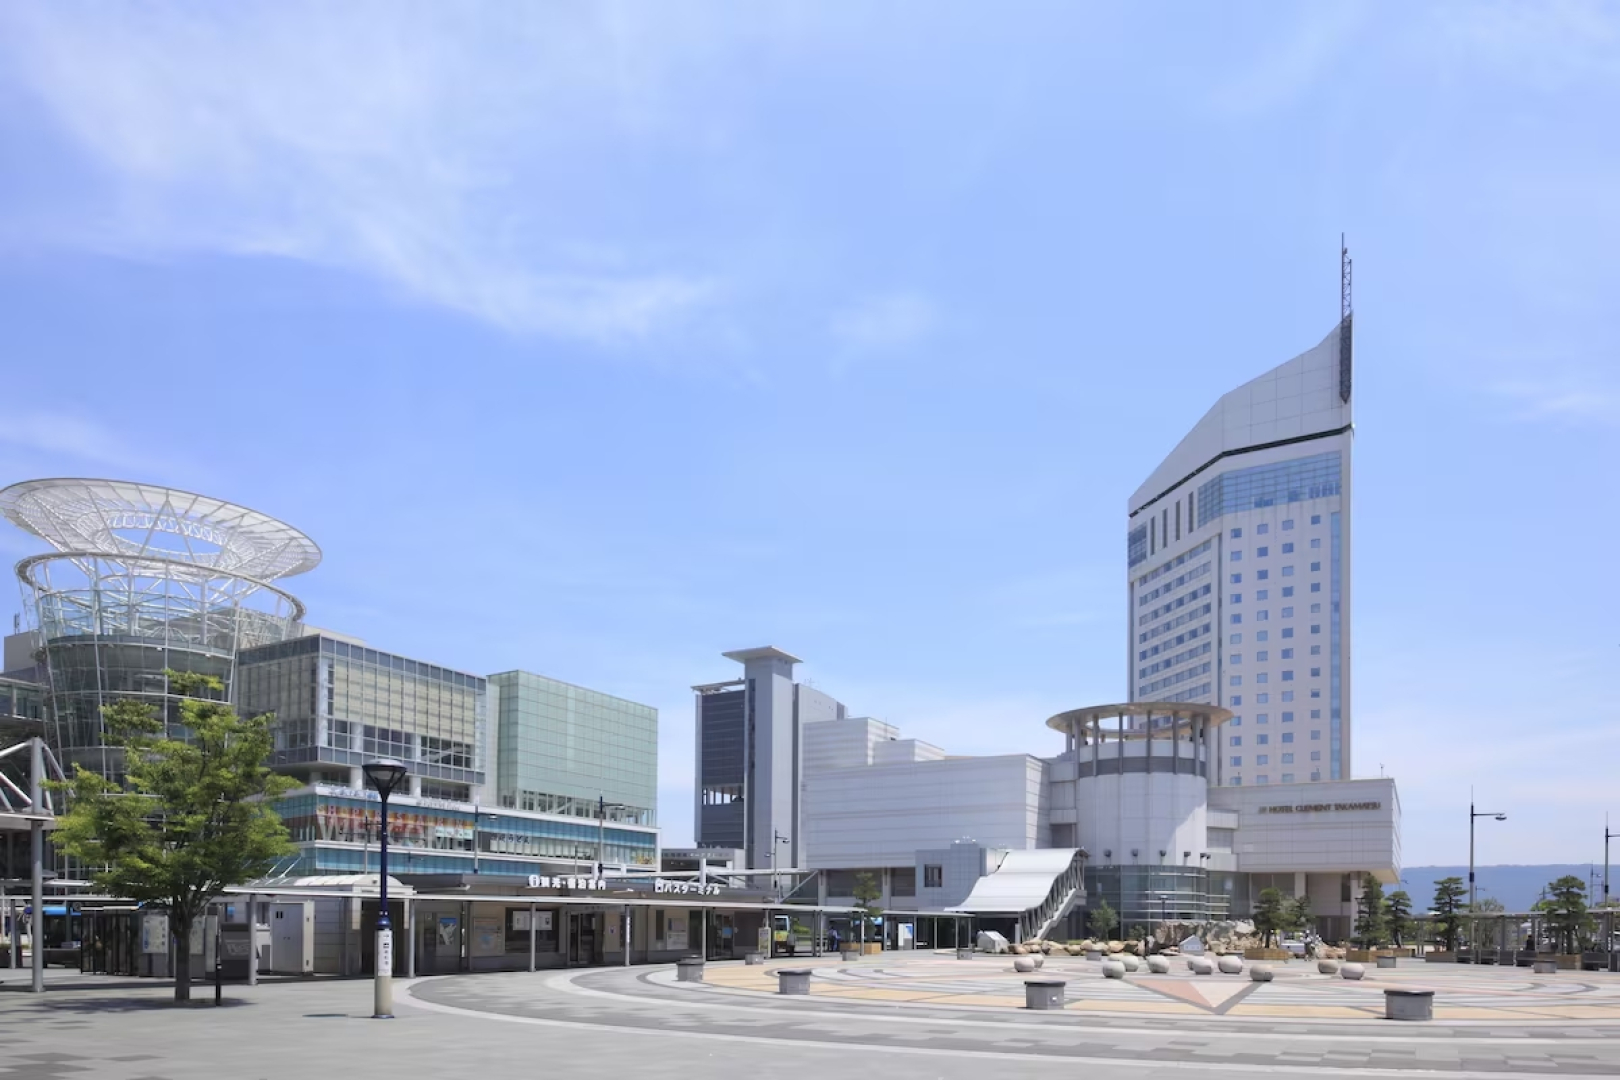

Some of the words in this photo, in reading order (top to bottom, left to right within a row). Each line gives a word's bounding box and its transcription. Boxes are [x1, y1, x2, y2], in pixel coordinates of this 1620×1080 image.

[1269, 805, 1293, 814] HOTEL
[1295, 804, 1331, 813] CLEMENT
[1334, 802, 1381, 811] TAKAMATSU
